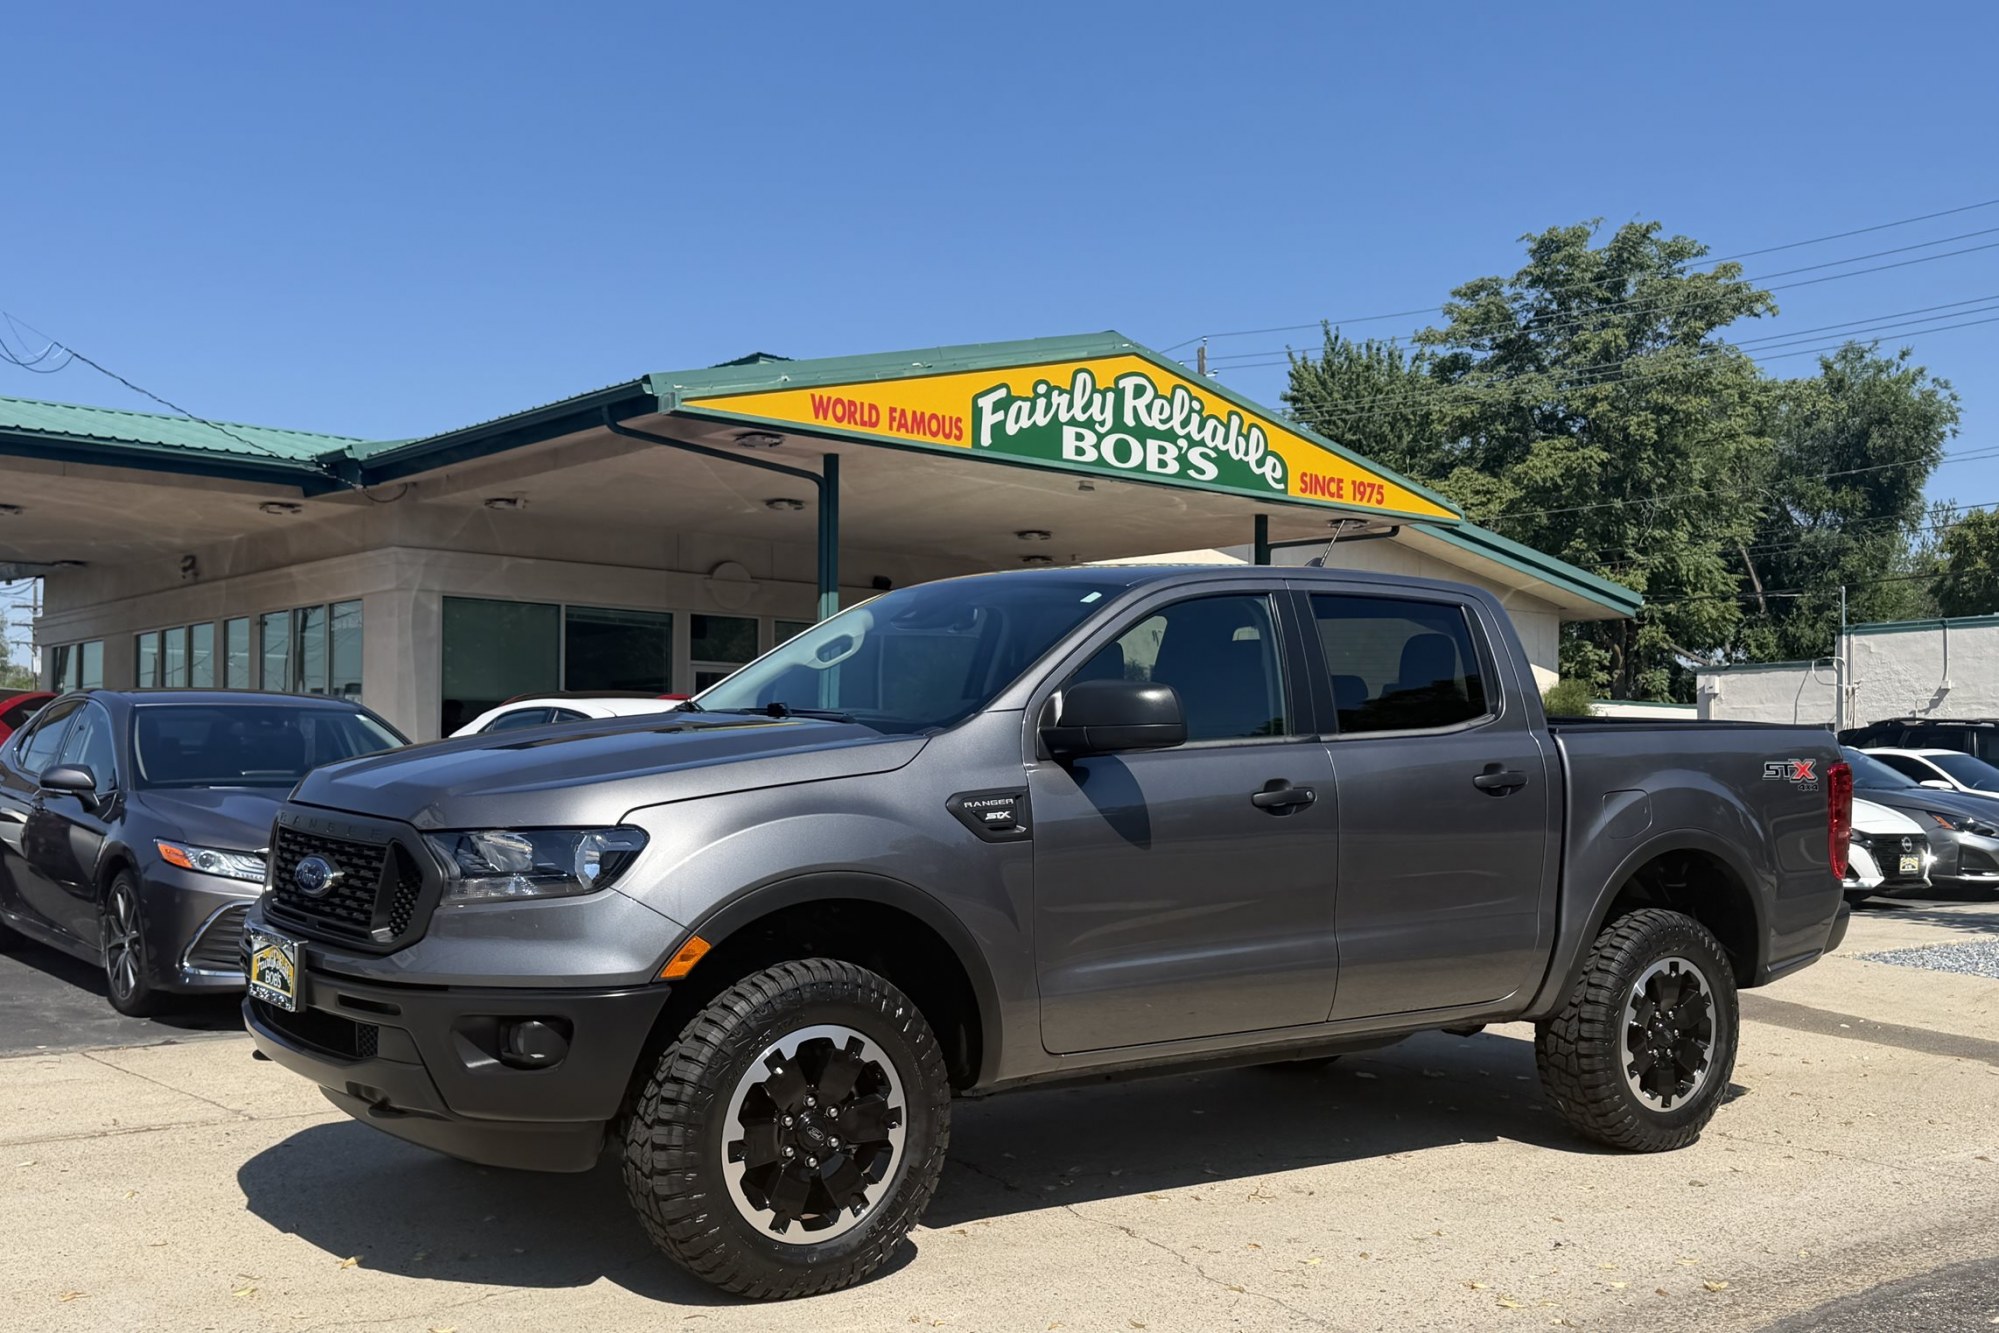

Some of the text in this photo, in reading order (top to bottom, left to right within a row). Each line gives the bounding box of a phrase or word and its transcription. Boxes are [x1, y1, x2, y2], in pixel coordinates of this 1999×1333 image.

[810, 393, 963, 441] WORLD FAMOUS
[977, 371, 1286, 490] Fairly Reliable
[1062, 425, 1219, 481] BOB'S
[1300, 471, 1385, 505] SINCE 1975
[1762, 759, 1818, 783] STX
[964, 798, 1014, 808] RANGER
[985, 811, 1011, 821] STX
